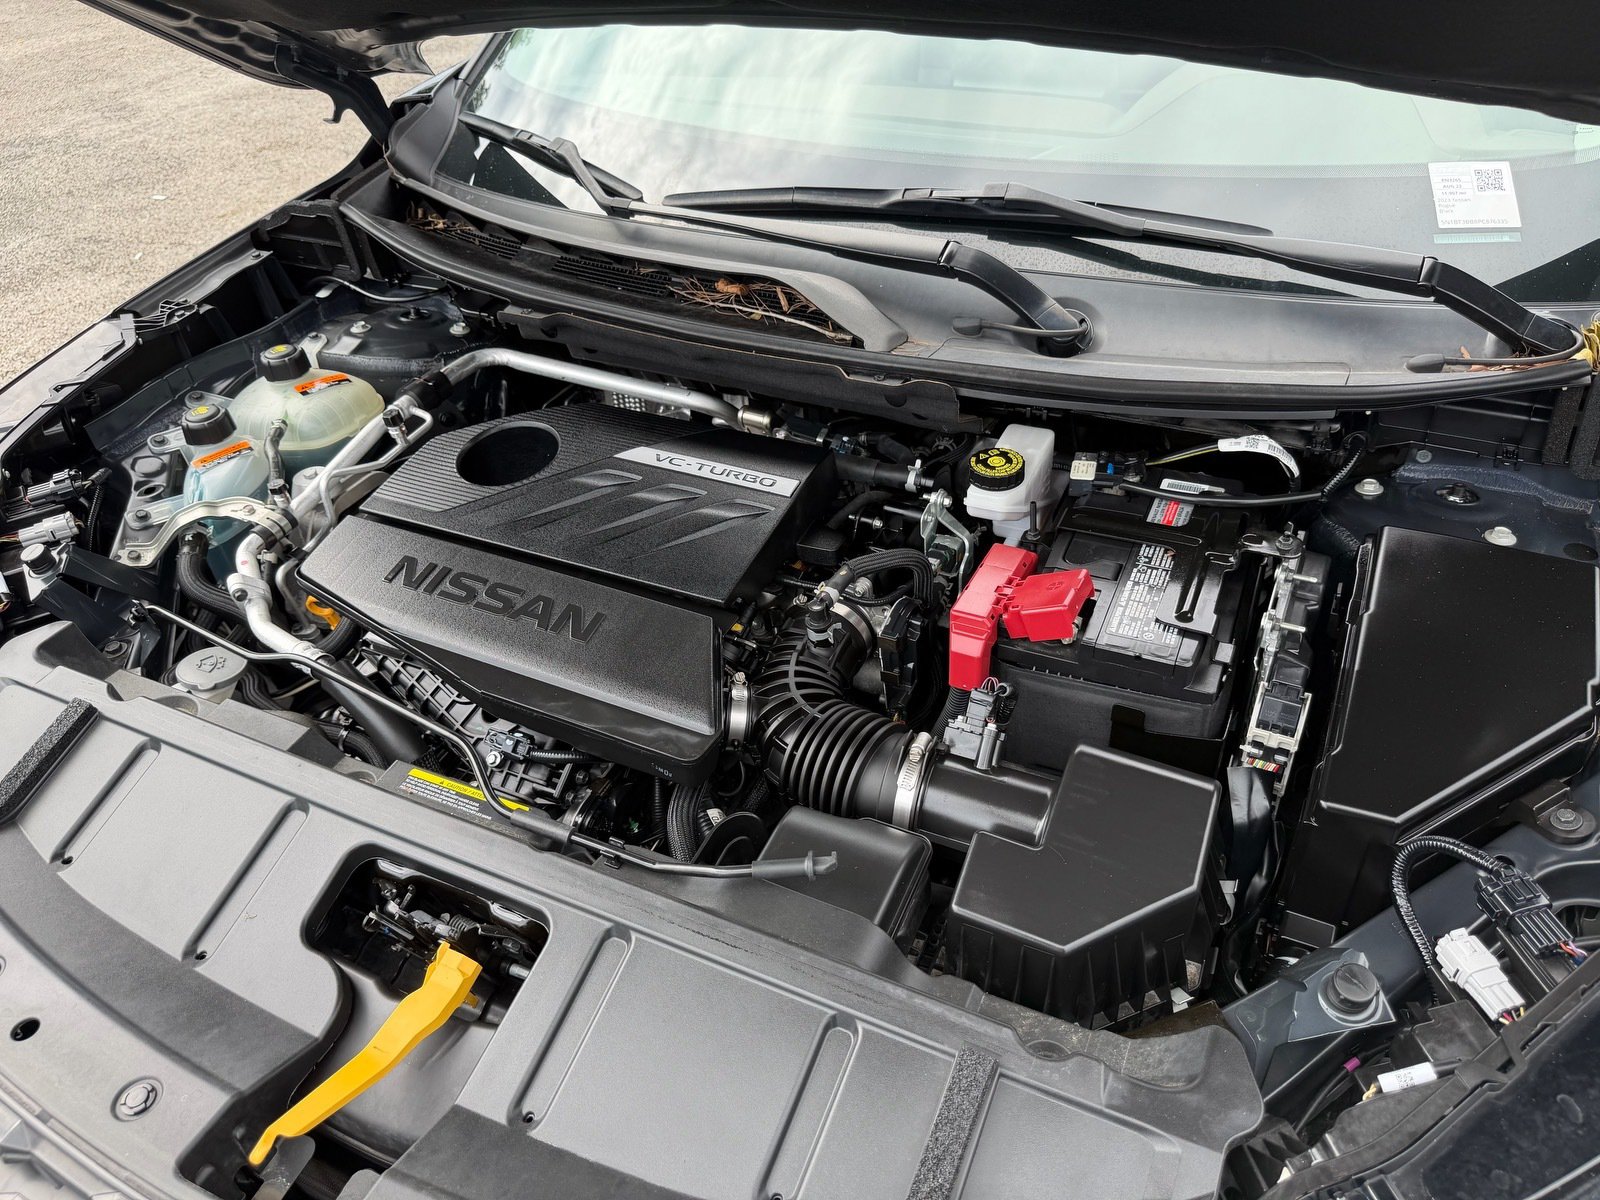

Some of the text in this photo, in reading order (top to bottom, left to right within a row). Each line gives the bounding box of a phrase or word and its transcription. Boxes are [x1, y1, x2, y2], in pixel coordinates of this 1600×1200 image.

[655, 453, 778, 488] VC-TURBO
[382, 554, 606, 644] NISSAN
[446, 782, 466, 794] CAUTION
